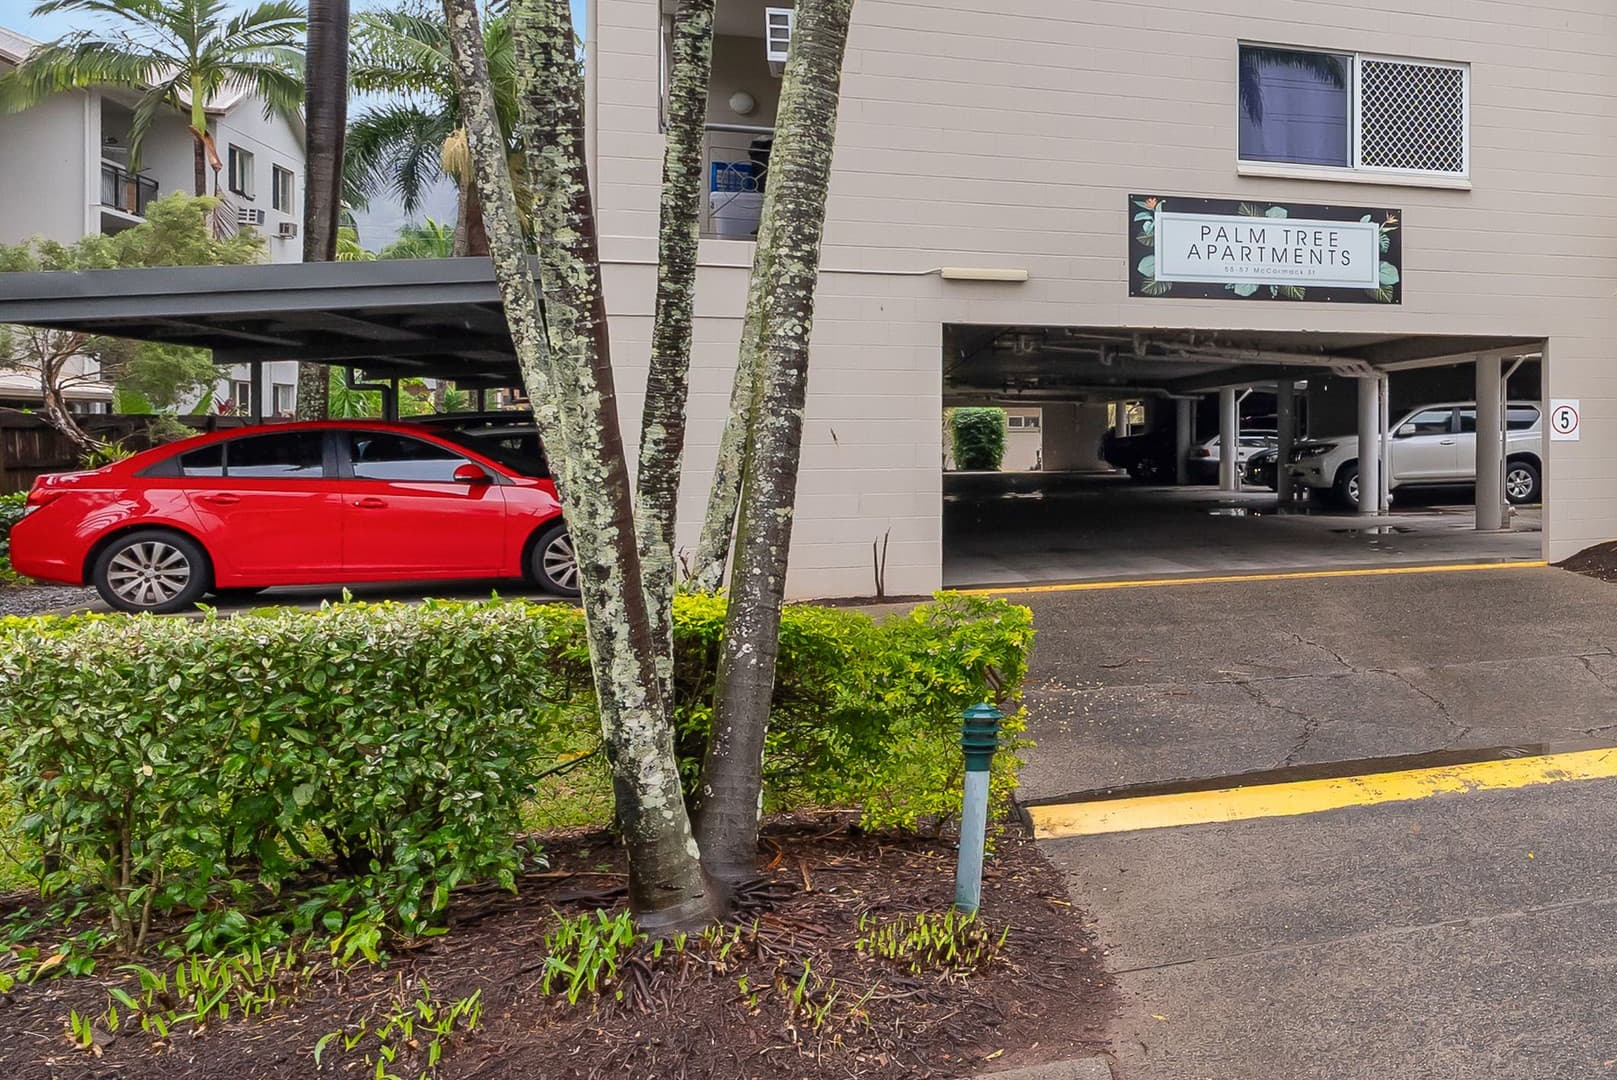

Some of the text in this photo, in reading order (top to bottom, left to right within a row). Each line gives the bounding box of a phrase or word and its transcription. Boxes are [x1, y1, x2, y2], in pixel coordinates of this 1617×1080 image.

[1200, 225, 1339, 248] PALM TREE
[1187, 243, 1352, 266] APARTMENTS
[1561, 411, 1569, 429] 5
